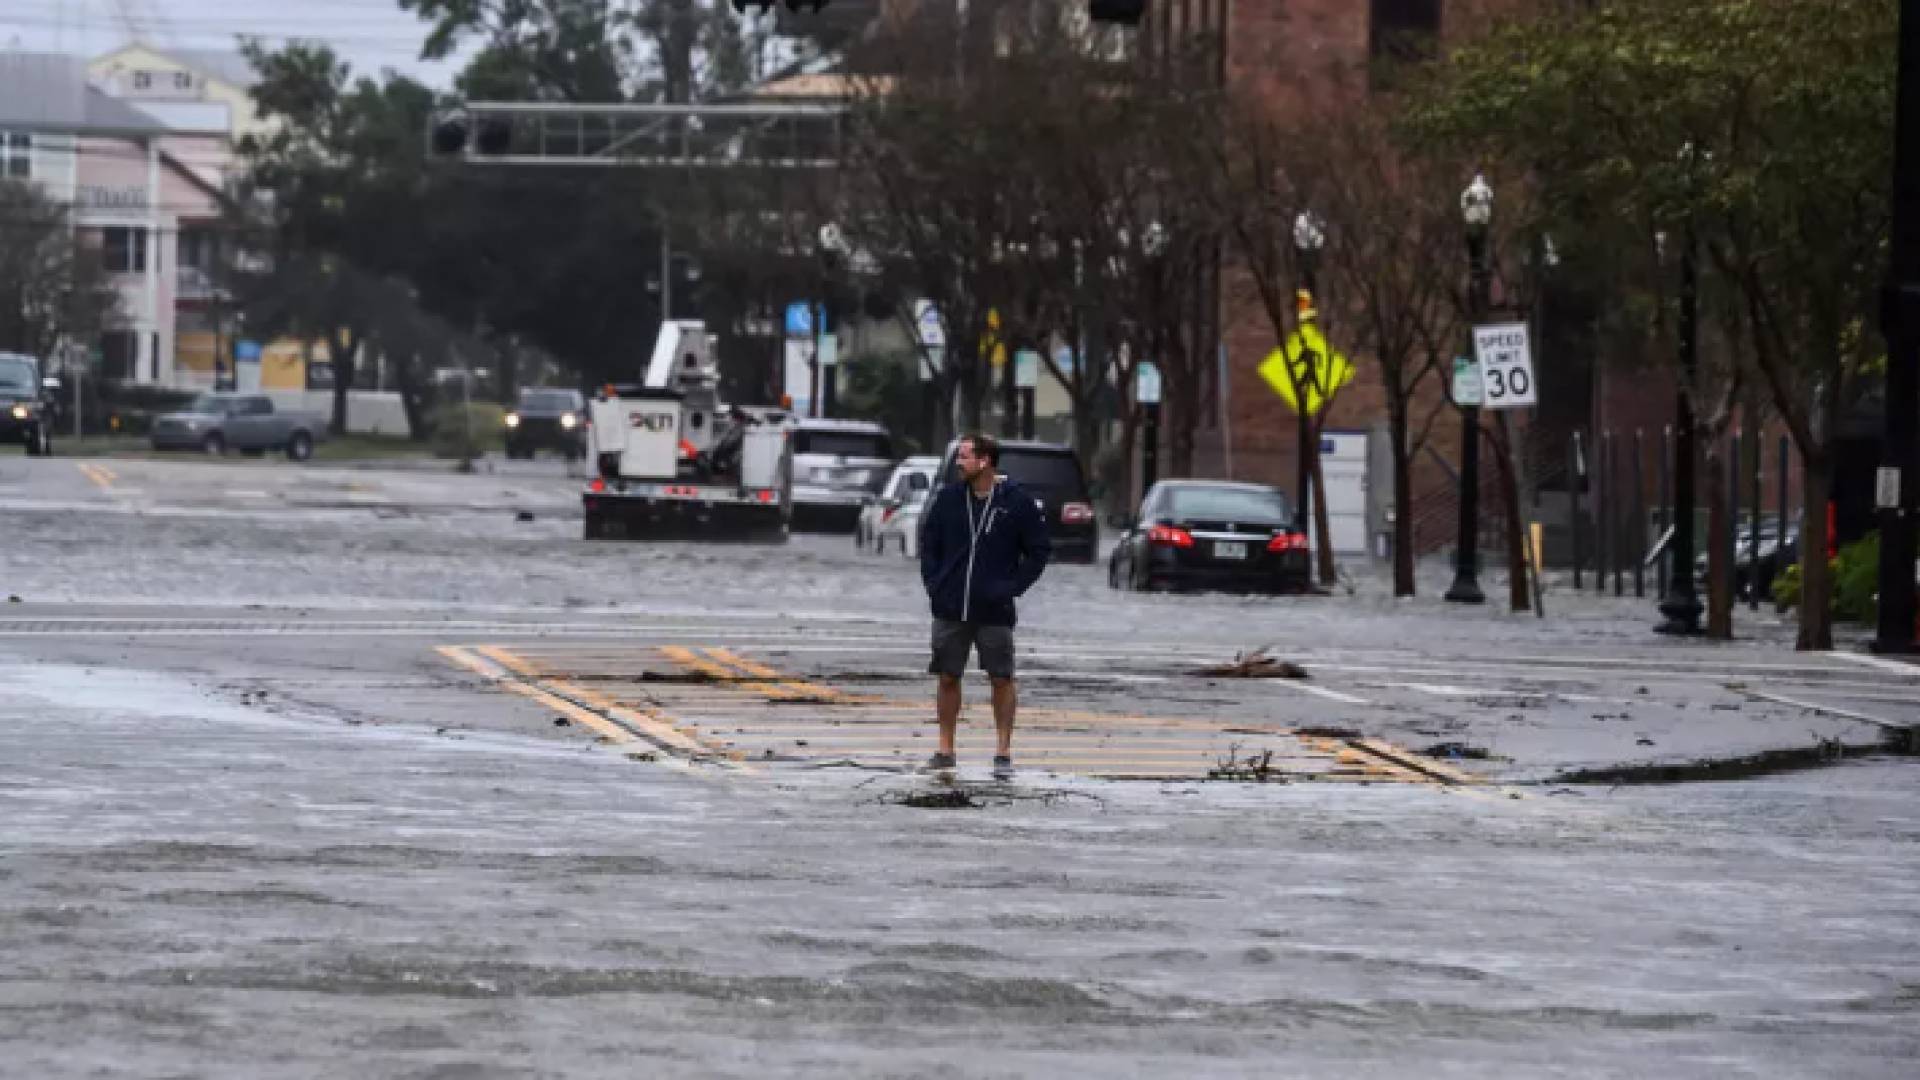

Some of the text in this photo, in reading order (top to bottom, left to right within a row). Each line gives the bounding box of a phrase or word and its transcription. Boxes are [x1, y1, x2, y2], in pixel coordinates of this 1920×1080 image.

[1479, 332, 1524, 349] SPEED
[1485, 349, 1521, 365] LIMIT
[1487, 367, 1529, 398] 30
